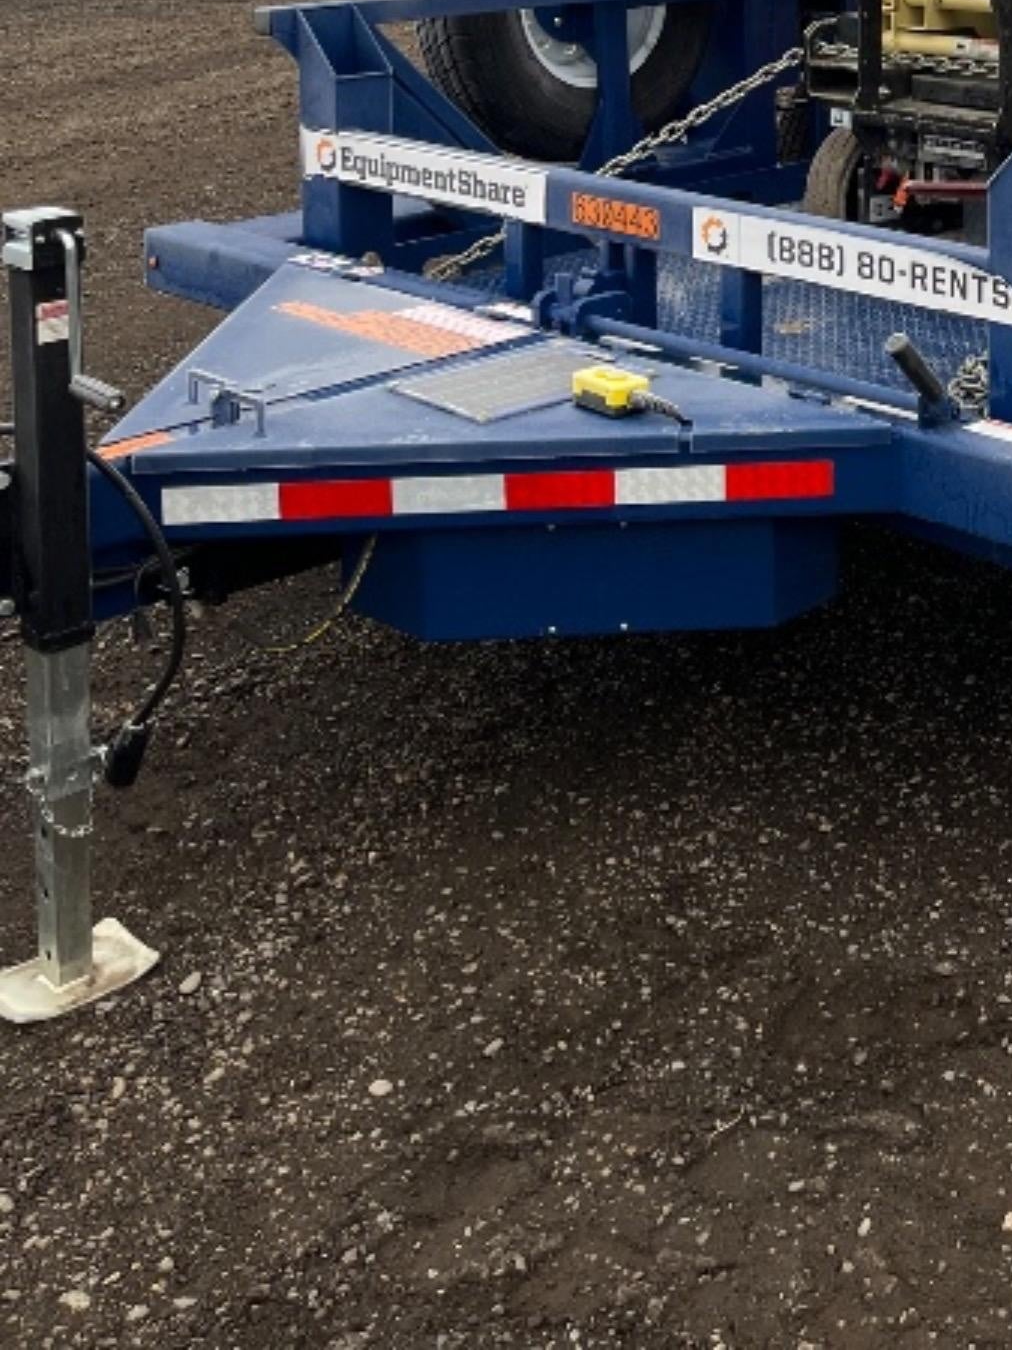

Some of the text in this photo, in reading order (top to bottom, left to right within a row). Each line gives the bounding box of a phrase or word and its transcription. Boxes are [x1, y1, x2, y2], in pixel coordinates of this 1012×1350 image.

[340, 146, 526, 207] EquipmentShare
[767, 229, 1012, 310] (888) 80-RENTS
